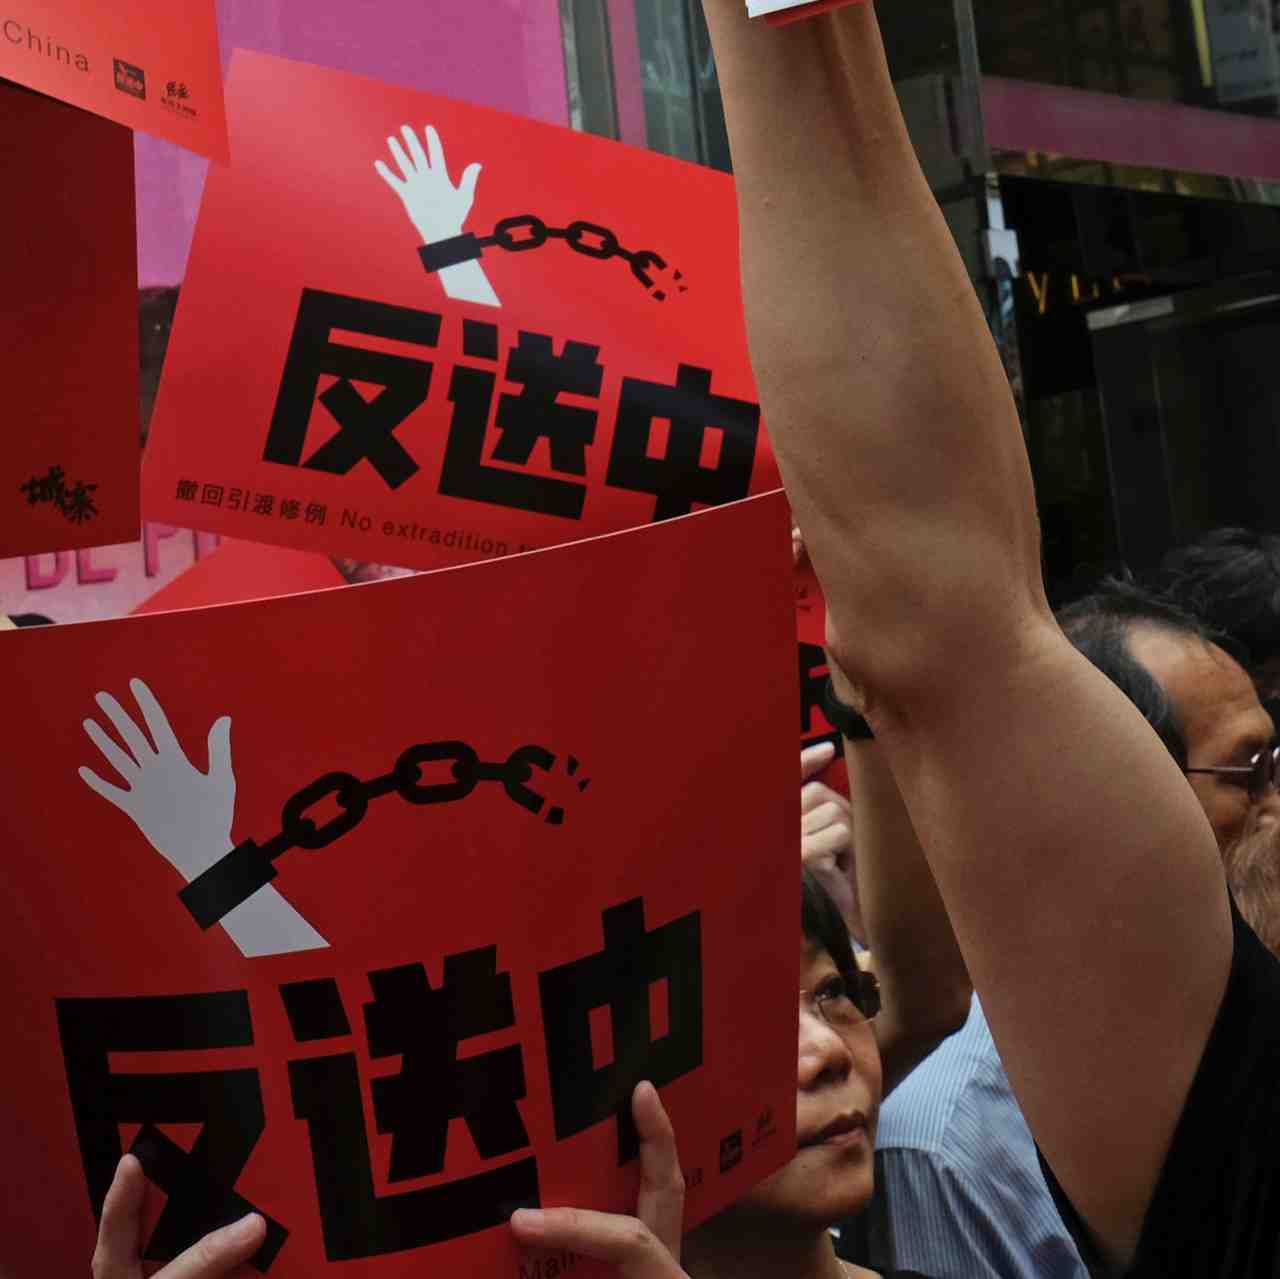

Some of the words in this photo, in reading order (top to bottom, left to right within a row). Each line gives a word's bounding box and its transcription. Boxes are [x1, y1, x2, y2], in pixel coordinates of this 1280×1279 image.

[3, 19, 90, 73] China
[262, 286, 762, 523] 反送中
[176, 478, 328, 527] 撤回引渡修例
[340, 507, 372, 532] No
[382, 516, 509, 556] extradition
[53, 895, 704, 1274] 反送中
